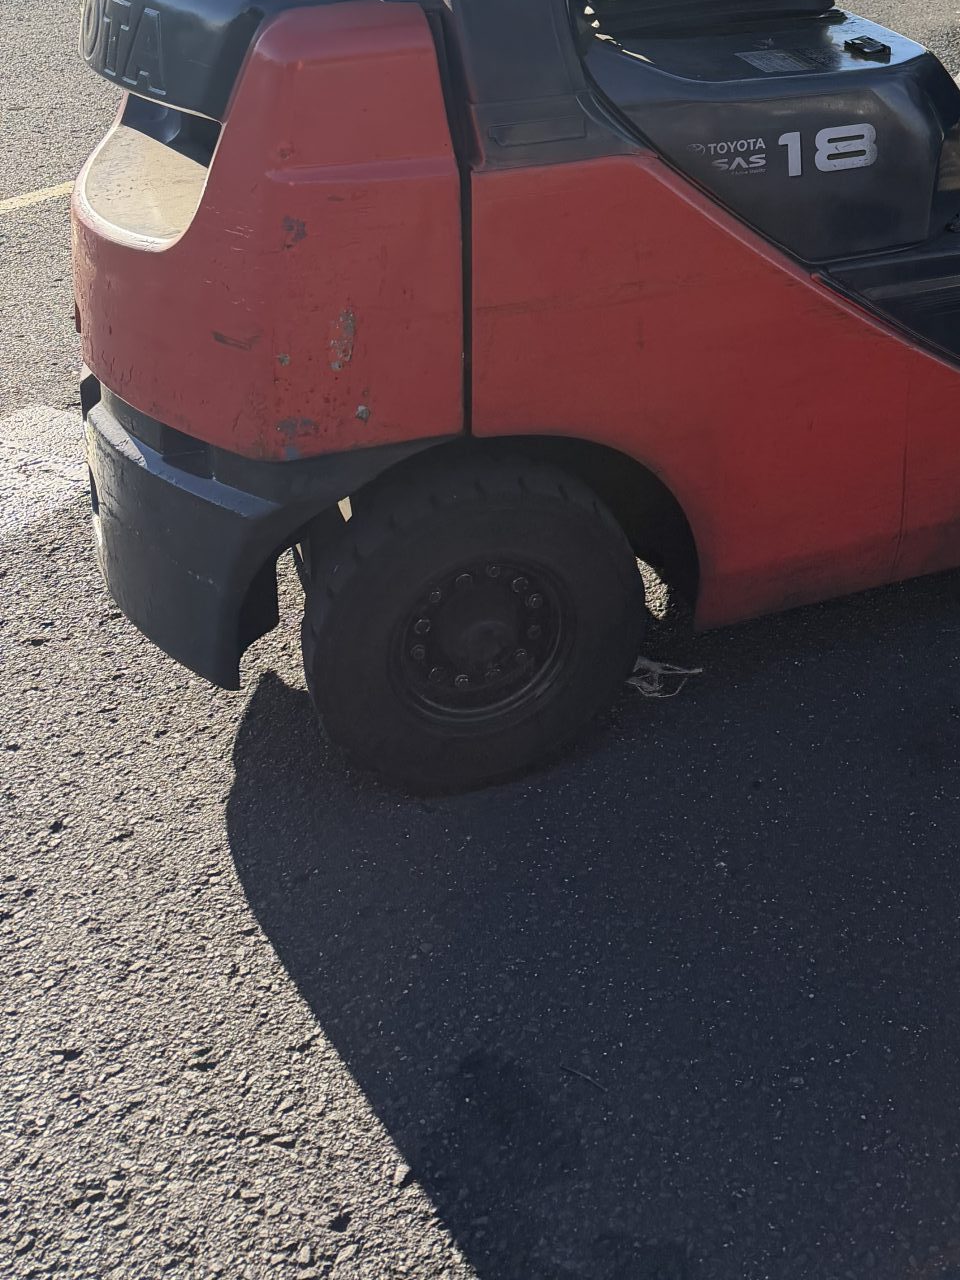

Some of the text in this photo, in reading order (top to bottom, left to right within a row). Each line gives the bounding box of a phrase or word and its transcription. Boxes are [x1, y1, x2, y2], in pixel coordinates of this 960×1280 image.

[708, 138, 766, 156] TOYOTA
[778, 123, 878, 178] 18
[712, 154, 766, 171] SAS
